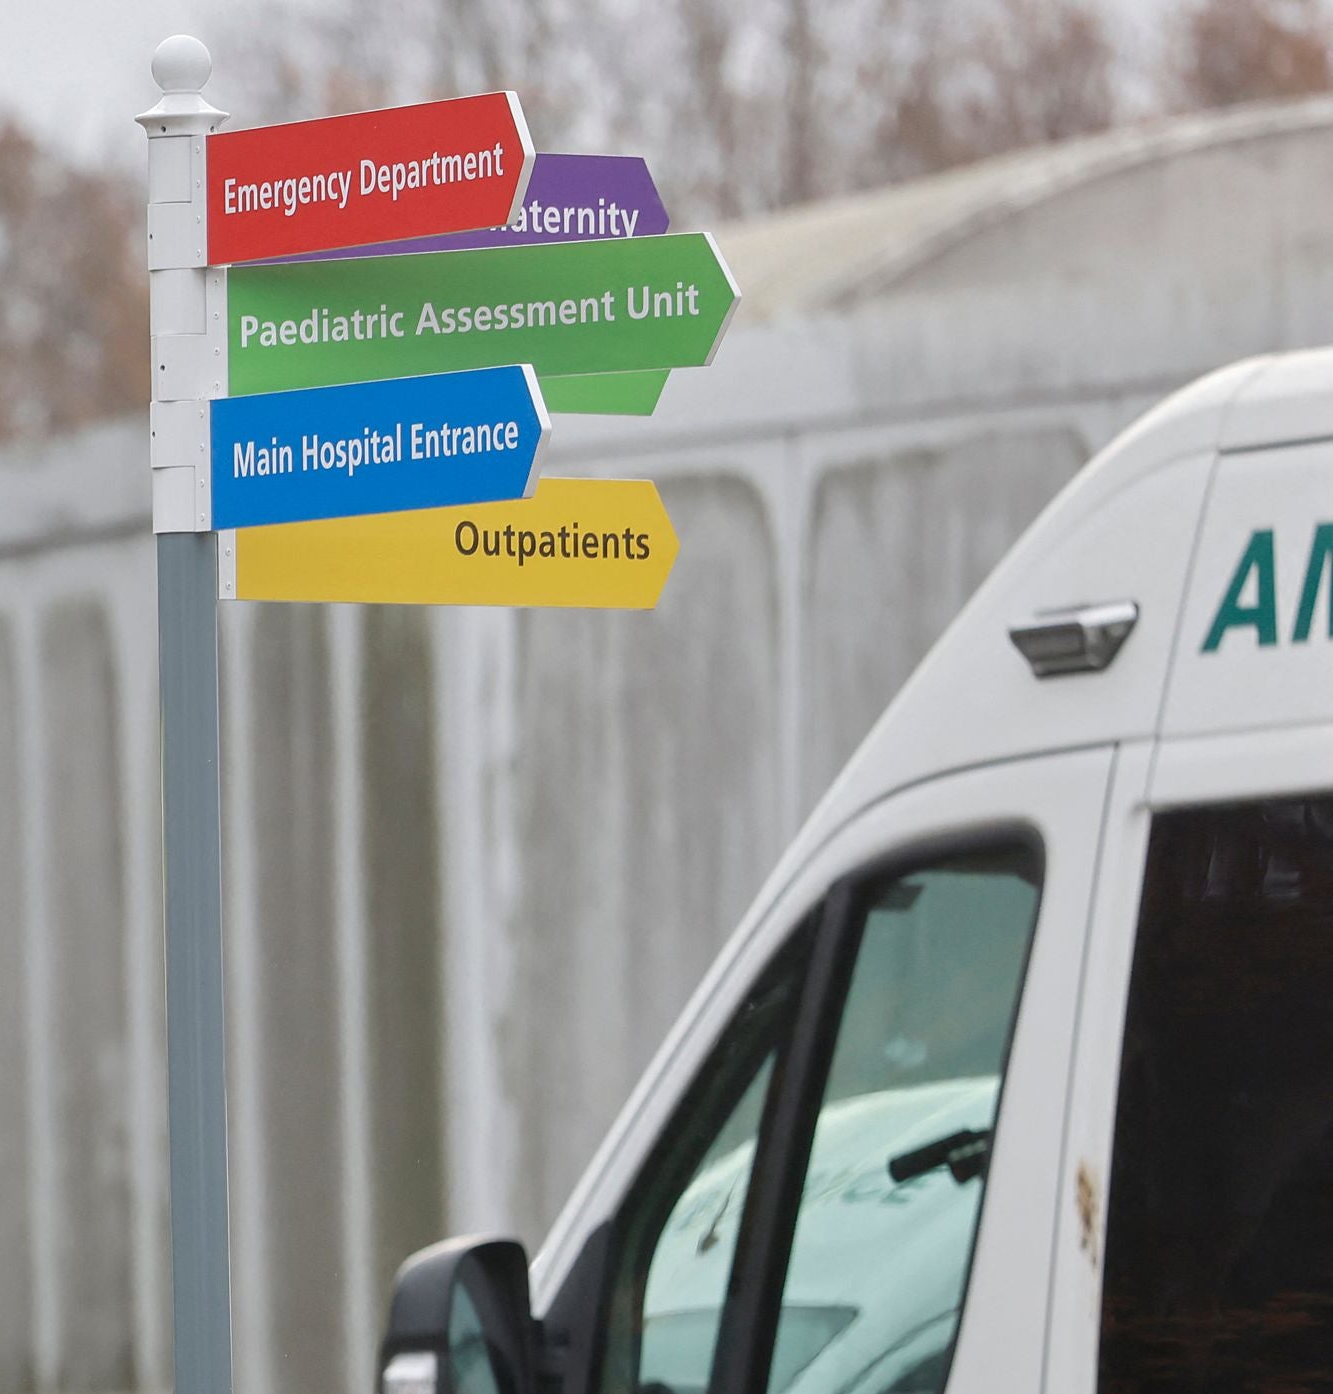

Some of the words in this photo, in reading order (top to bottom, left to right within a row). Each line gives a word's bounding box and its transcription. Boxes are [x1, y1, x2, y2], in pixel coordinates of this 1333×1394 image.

[224, 166, 351, 216] Emergency
[360, 142, 504, 201] Department
[490, 197, 639, 238] aternity
[240, 303, 404, 348] Paediatric
[415, 289, 615, 338] Assessment
[627, 282, 700, 321] Unit
[233, 437, 293, 479] Main
[302, 427, 402, 476] Hospital
[411, 420, 519, 460] Entrance
[454, 520, 651, 566] Outpatients
